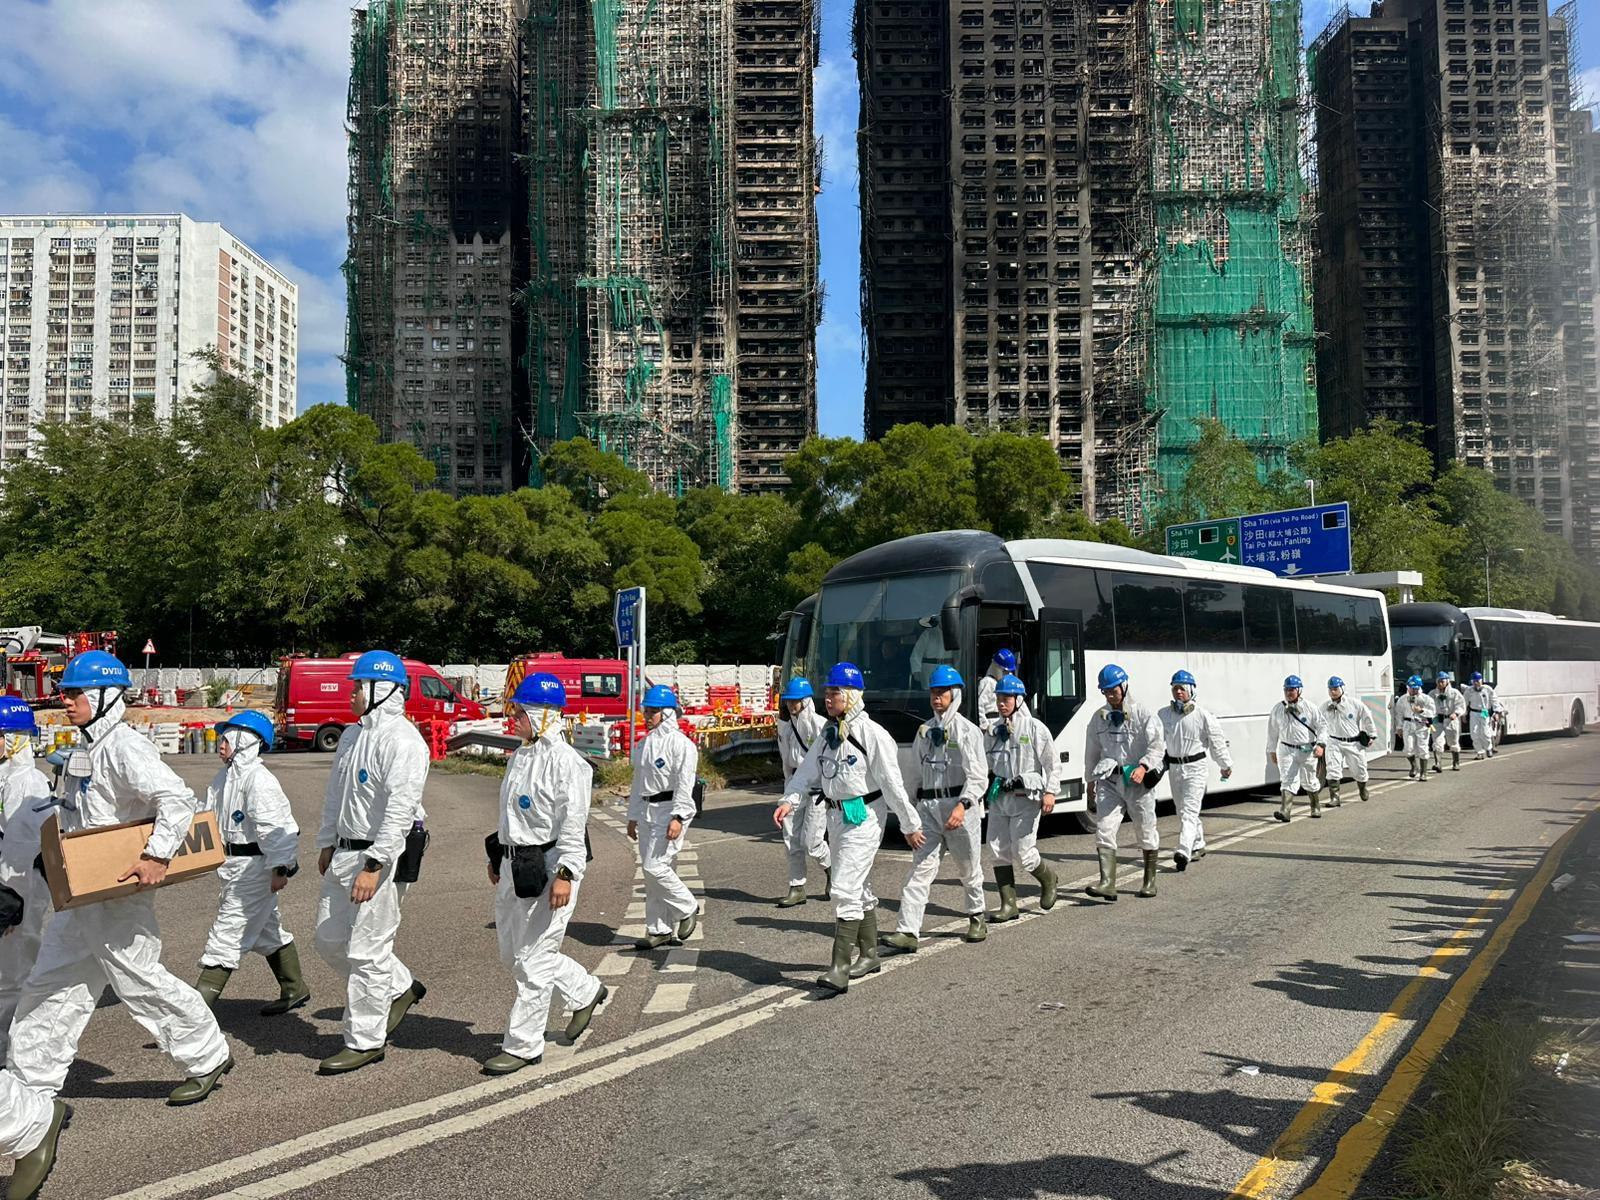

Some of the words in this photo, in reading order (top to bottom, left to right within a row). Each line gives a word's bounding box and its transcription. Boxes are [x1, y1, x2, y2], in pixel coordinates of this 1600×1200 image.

[1243, 520, 1257, 528] Sha
[1258, 518, 1269, 526] Tin
[1170, 529, 1183, 537] Sha
[1171, 538, 1189, 550] 沙田
[1244, 542, 1255, 550] Tai
[1256, 540, 1266, 548] Po
[101, 667, 123, 675] DVIU
[540, 681, 559, 689] DVIU
[174, 821, 215, 857] M
